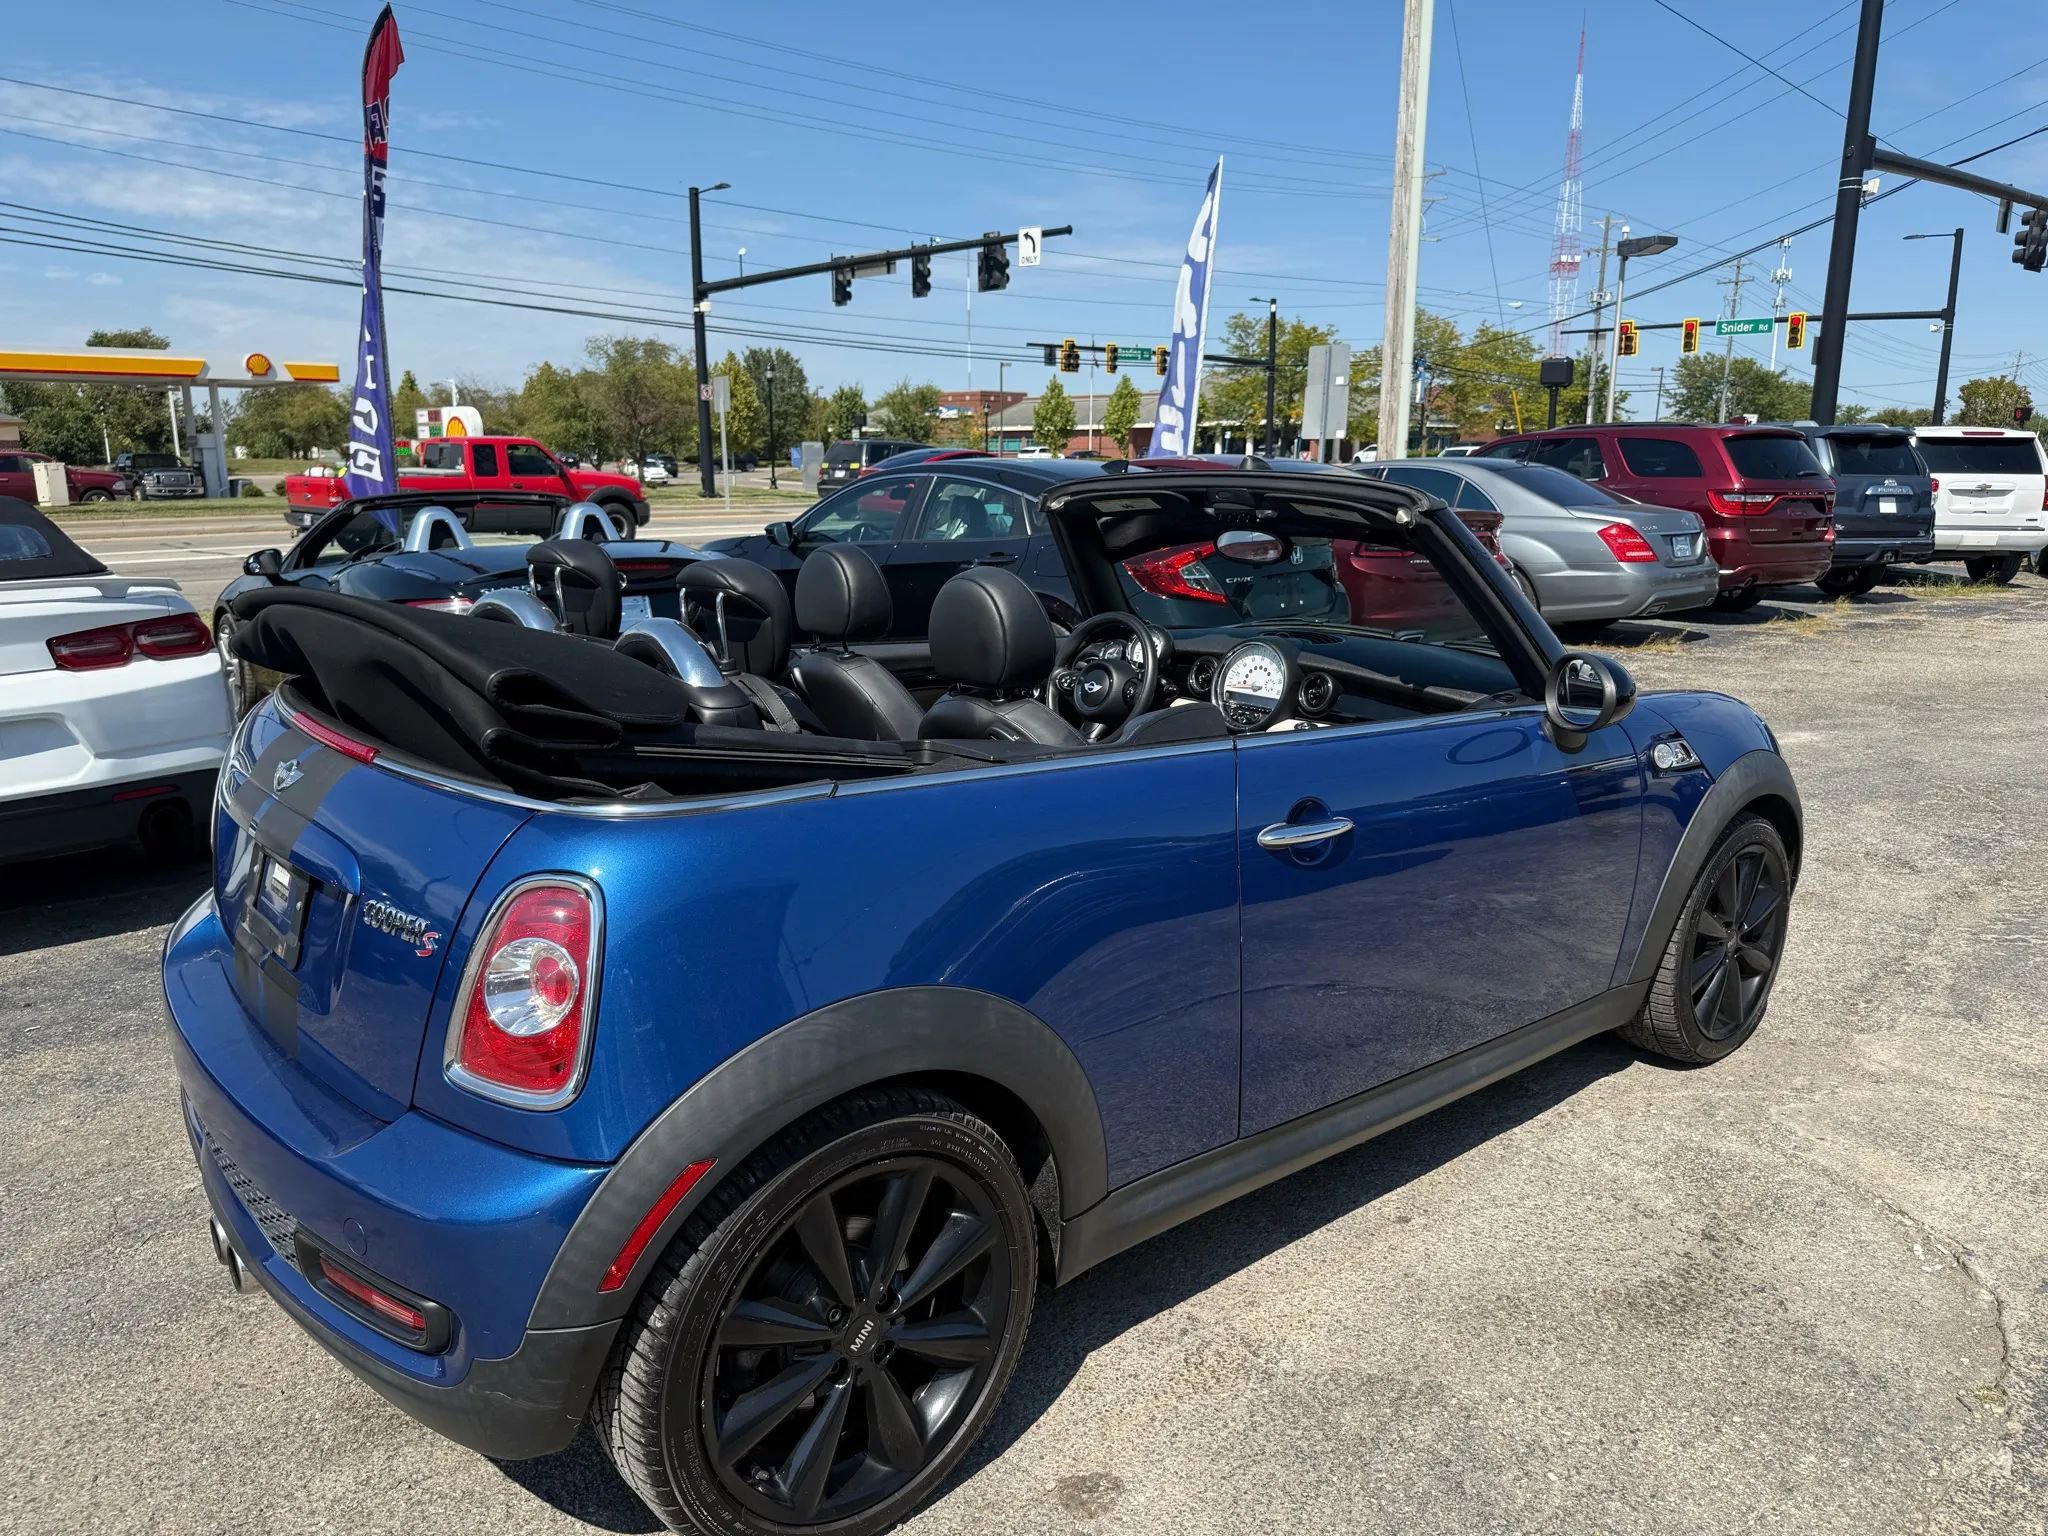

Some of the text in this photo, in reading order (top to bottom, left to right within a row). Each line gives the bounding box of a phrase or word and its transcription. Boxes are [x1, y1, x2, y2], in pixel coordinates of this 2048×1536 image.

[1020, 256, 1038, 264] ONLY
[1721, 322, 1769, 333] Snider Rd
[1225, 576, 1254, 584] CIVIC
[363, 899, 441, 957] COOPER S
[849, 1319, 875, 1352] MINI
